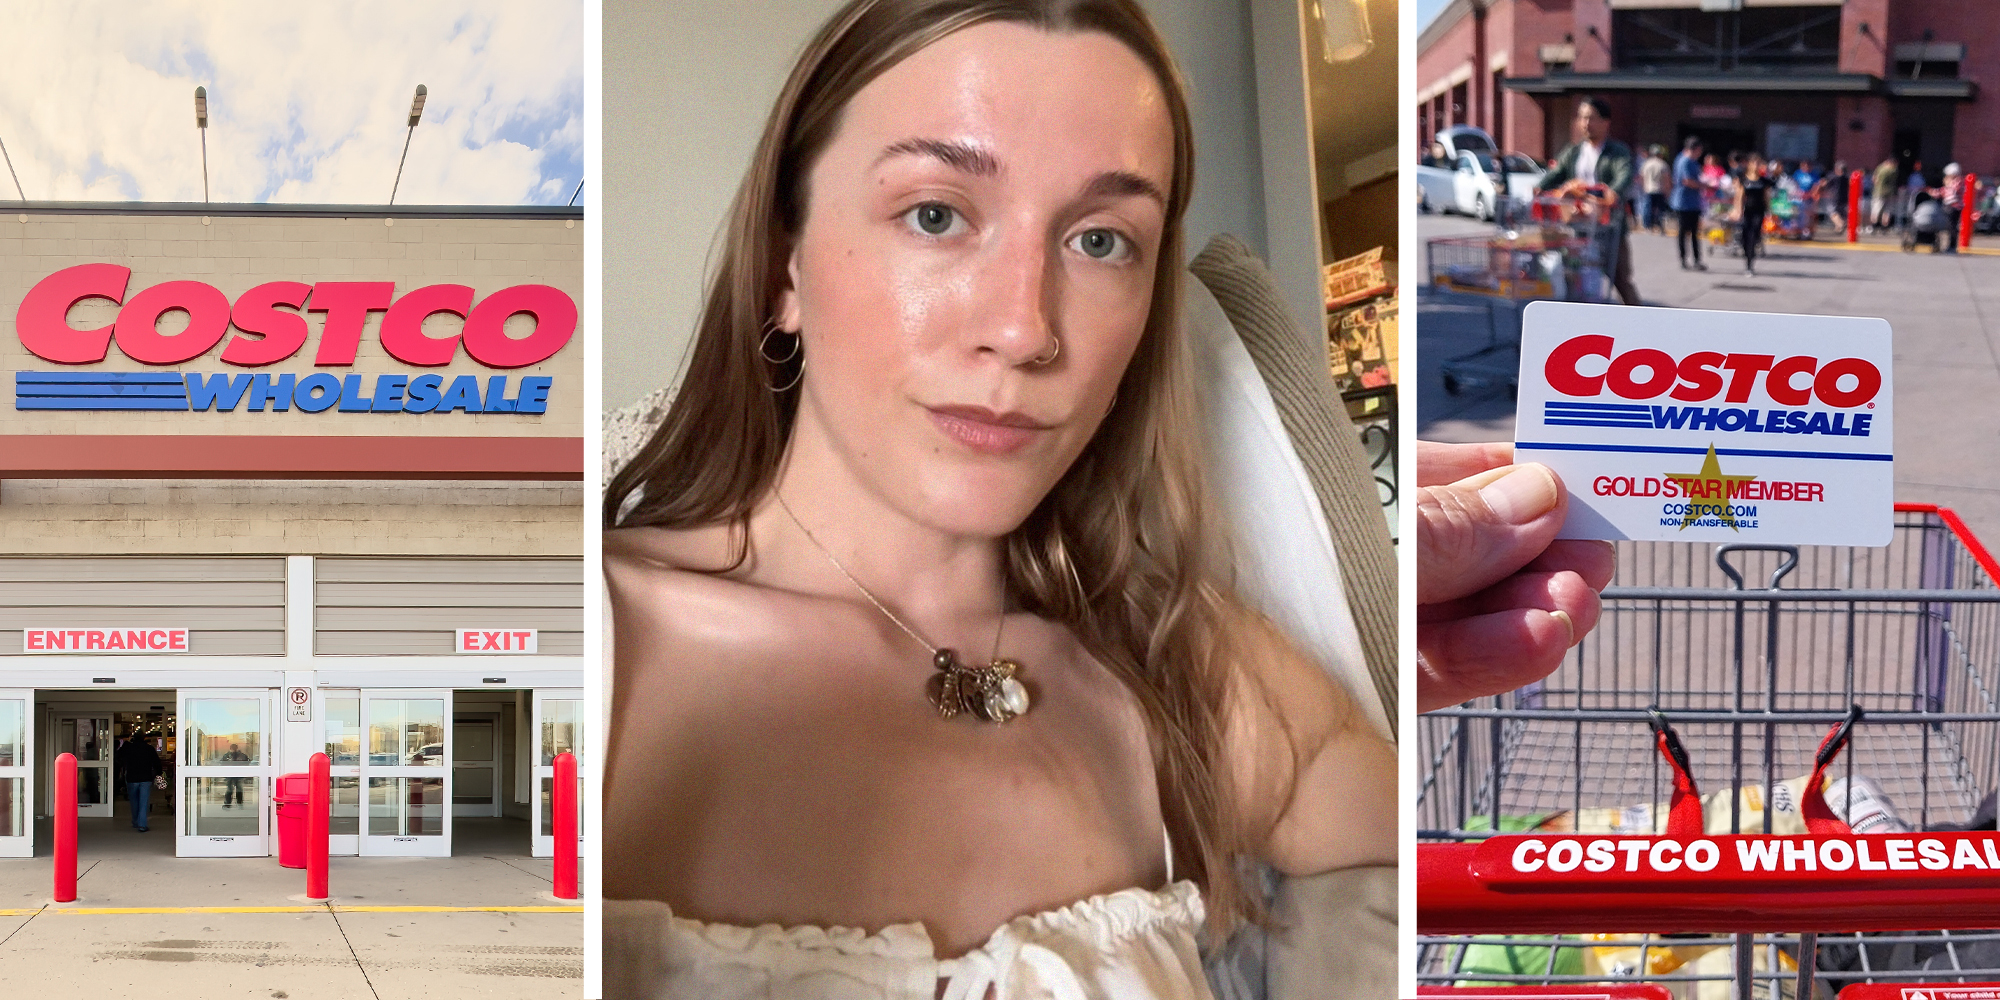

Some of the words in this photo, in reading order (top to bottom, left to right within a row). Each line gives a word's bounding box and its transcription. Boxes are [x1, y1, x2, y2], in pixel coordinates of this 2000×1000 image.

[16, 263, 578, 368] COSTCO
[1544, 334, 1882, 408] COSTCO
[186, 373, 553, 415] WHOLESALE
[1651, 405, 1873, 437] WHOLESALE
[1593, 475, 1660, 497] GOLD
[1662, 477, 1722, 499] STAR
[1726, 479, 1824, 502] MEMBER
[1660, 518, 1759, 528] NON-TRANSFERABLE
[1663, 503, 1757, 517] COSTCO.COM
[27, 630, 187, 650] ENTRANCE
[463, 631, 531, 651] EXIT
[1511, 839, 1720, 873] COSTCO
